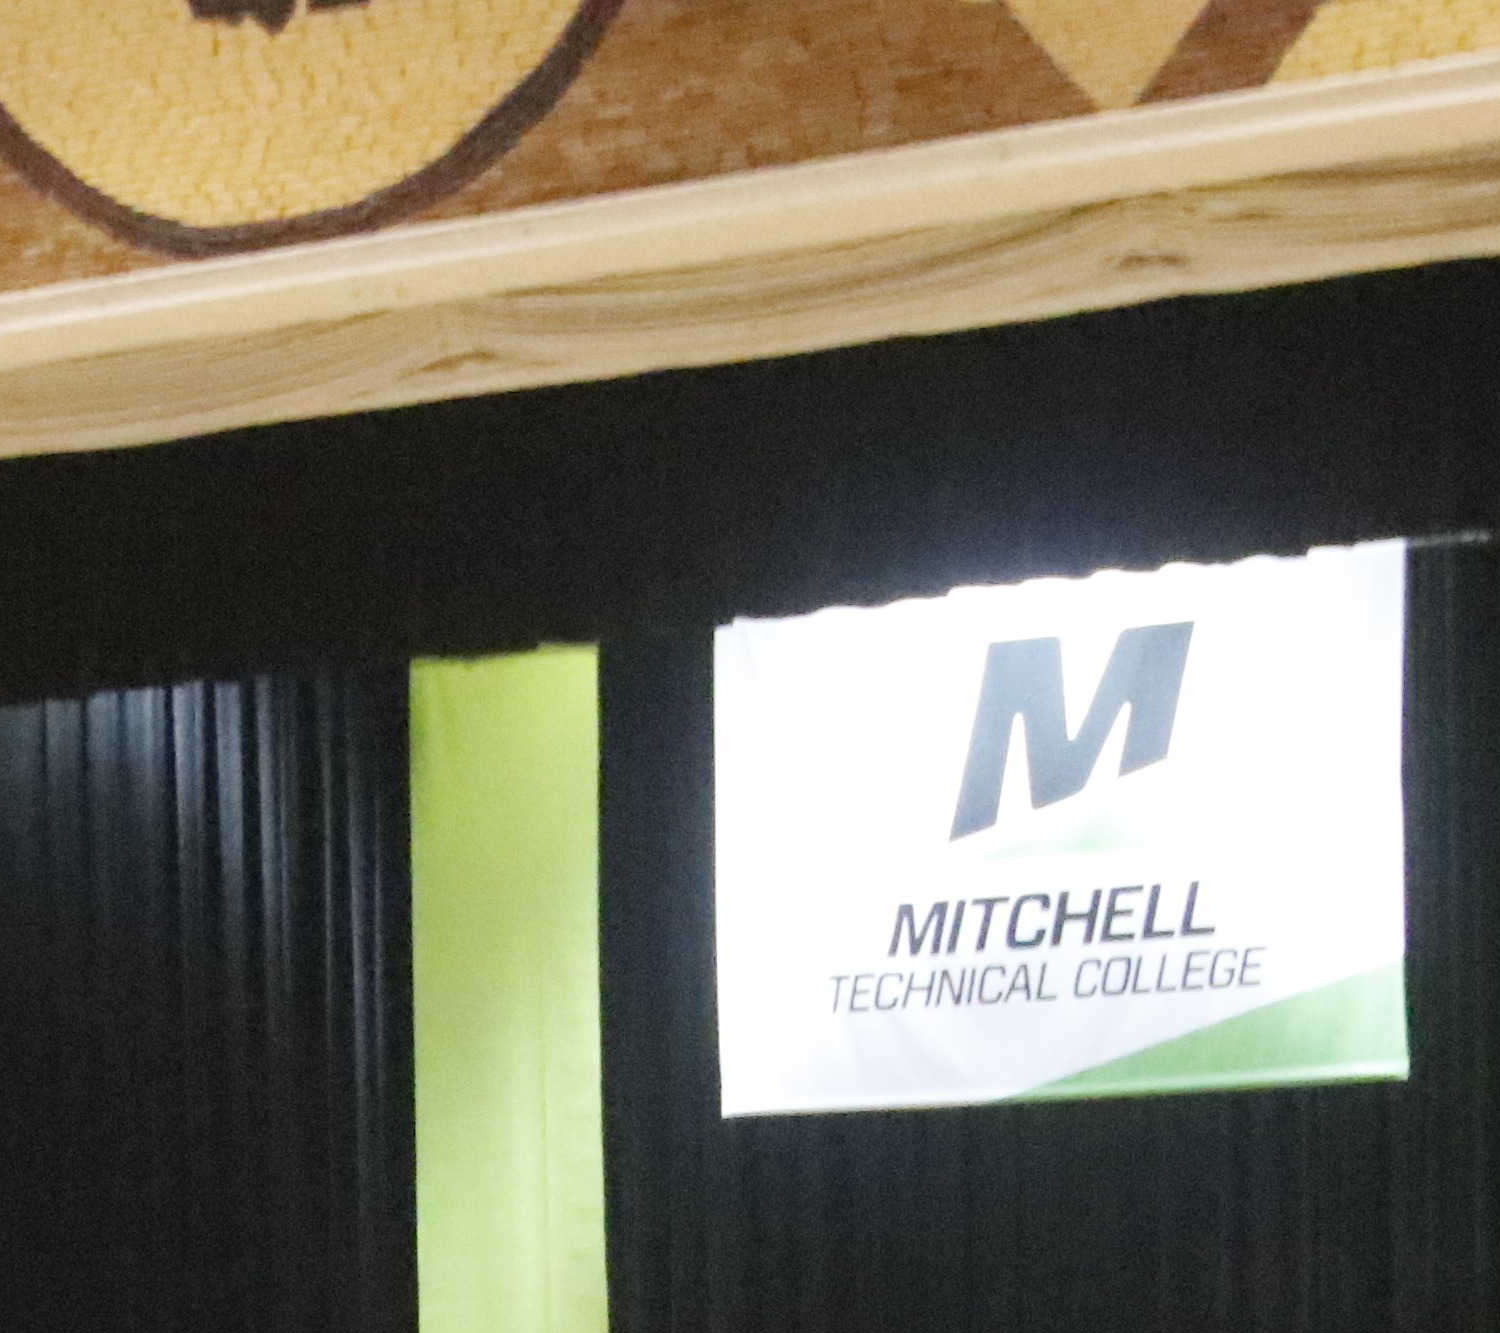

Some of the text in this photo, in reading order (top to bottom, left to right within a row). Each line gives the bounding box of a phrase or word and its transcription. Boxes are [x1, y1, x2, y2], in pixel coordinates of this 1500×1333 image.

[949, 621, 1195, 842] M
[888, 881, 1216, 957] MITCHELL
[829, 946, 1268, 1014] TECHNICAL COLLEGE
